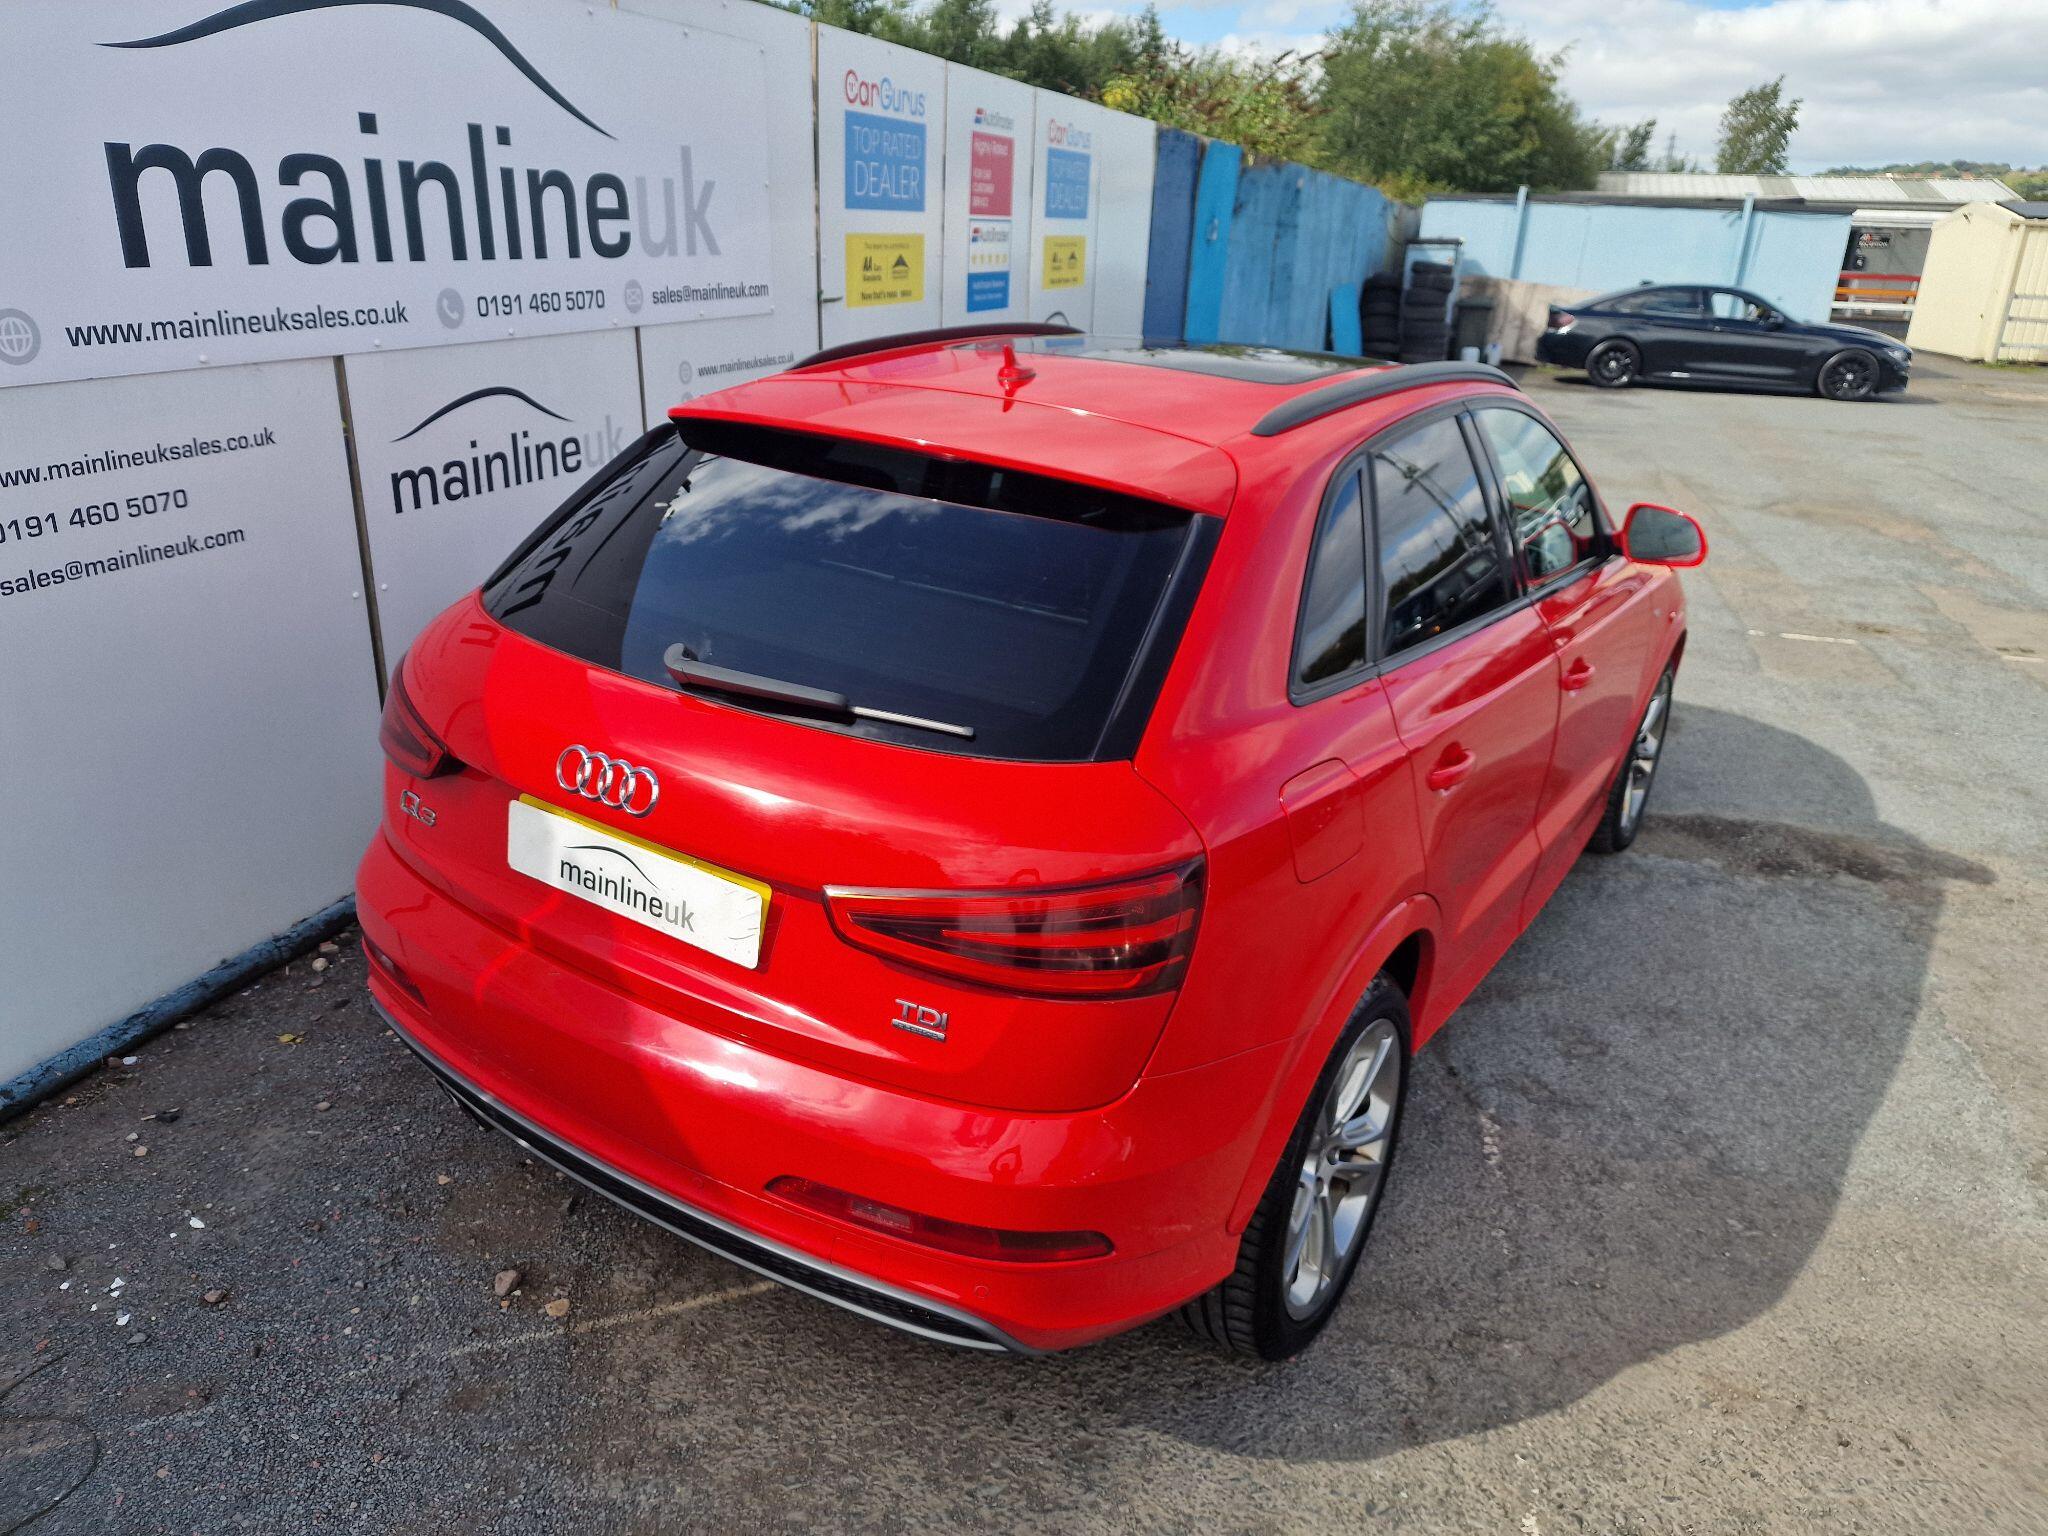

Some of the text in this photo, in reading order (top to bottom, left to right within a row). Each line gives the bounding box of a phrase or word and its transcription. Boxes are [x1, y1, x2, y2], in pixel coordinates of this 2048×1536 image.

[845, 69, 926, 116] CarGurus
[853, 126, 880, 154] TOP
[855, 160, 920, 200] DEALER
[477, 289, 605, 317] 0191 460 5070
[652, 280, 769, 304] sales@mainlineuk.com
[65, 300, 409, 347] www.mainlineuksales.co.uk
[69, 501, 120, 529] 460
[126, 488, 189, 518] 5070
[0, 528, 245, 596] sales@mainlineuk.com
[401, 789, 436, 827] Q3
[895, 998, 949, 1031] TDI
